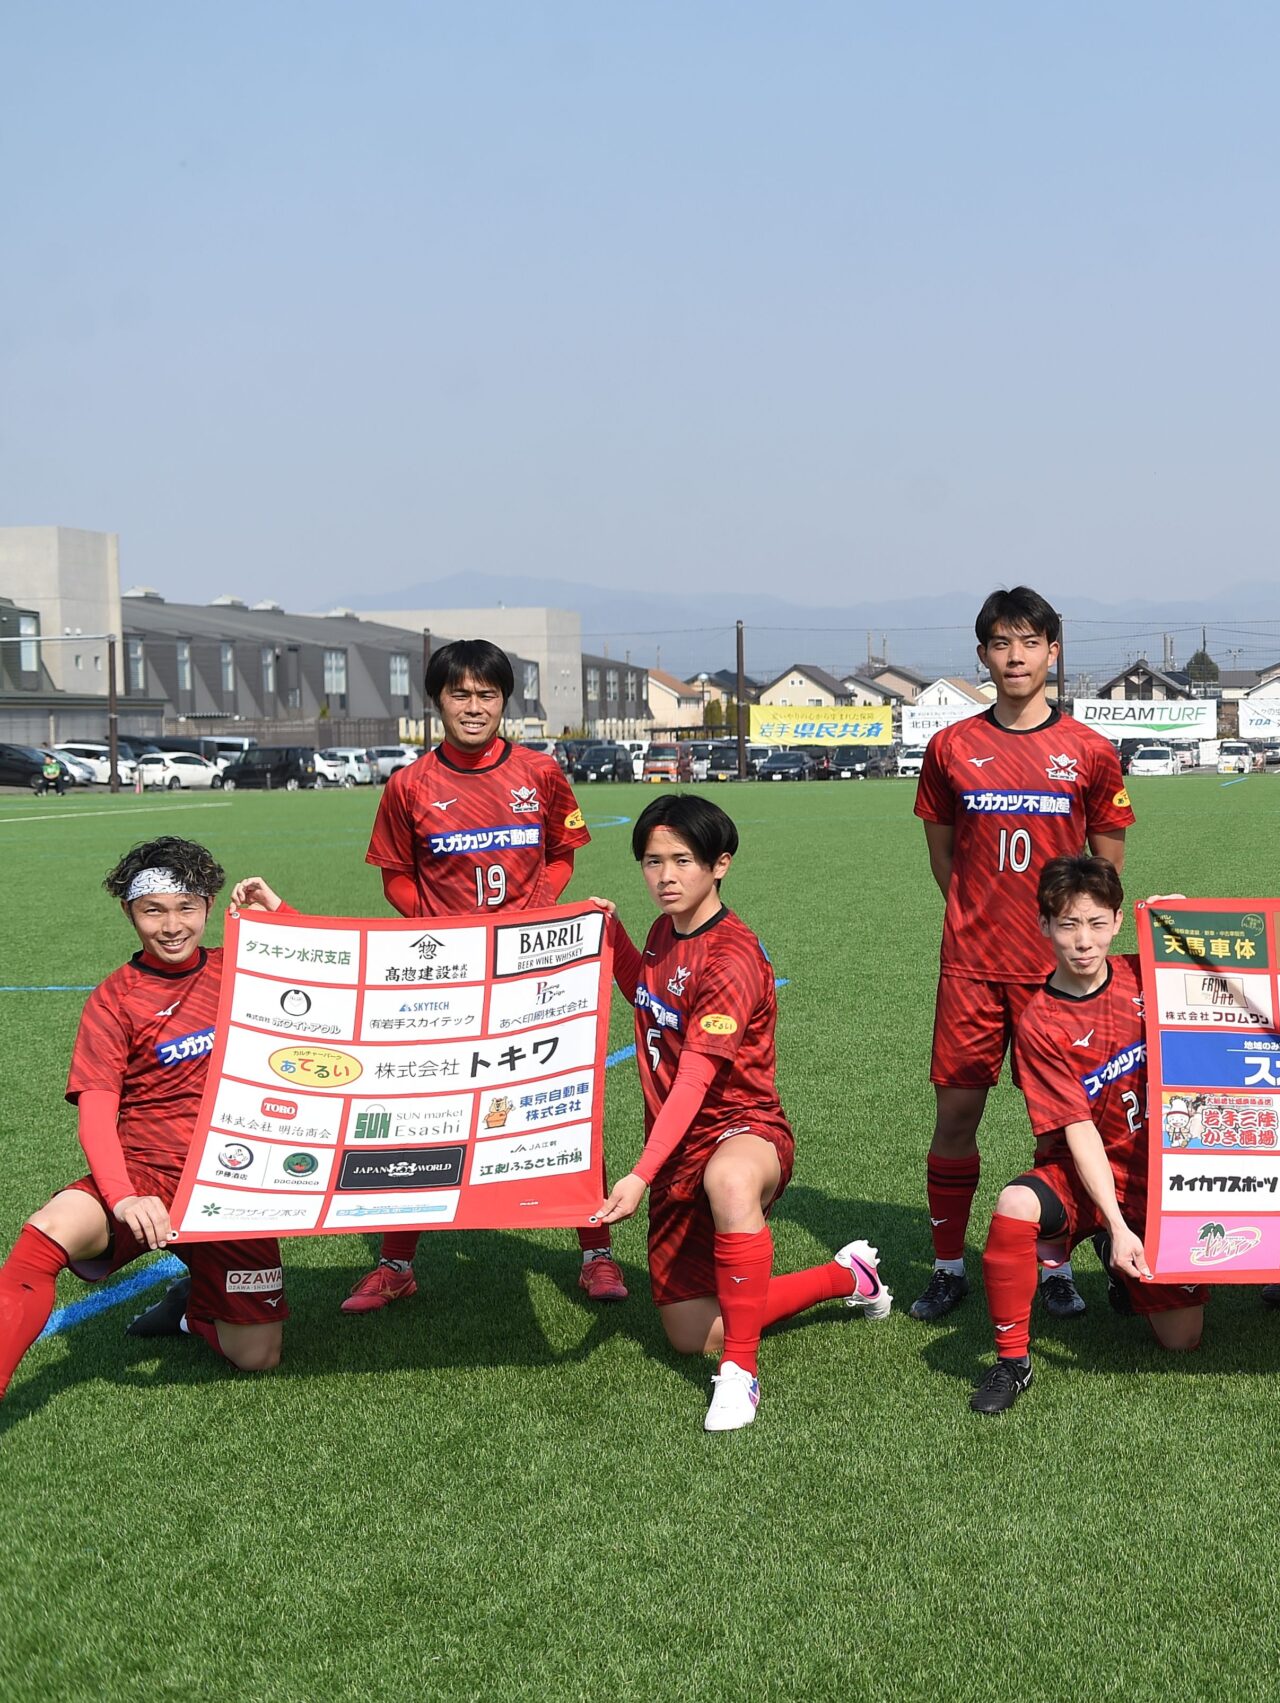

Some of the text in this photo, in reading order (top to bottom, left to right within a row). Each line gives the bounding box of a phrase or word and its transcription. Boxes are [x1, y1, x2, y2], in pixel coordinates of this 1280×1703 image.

[1084, 706, 1207, 721] DREAMTURF
[759, 722, 884, 739] 岩手 県民共済
[963, 792, 1071, 814] スガカツ不動産
[431, 828, 540, 854] スガカツ不動産
[998, 828, 1032, 873] 10
[475, 864, 506, 907] 19
[519, 923, 584, 954] BARRIL
[1163, 934, 1256, 960] 天馬車体
[246, 940, 351, 965] ダスキン水沢支店
[517, 948, 584, 971] BEER WINE WHISKEY
[413, 1001, 450, 1012] SKYTECH
[499, 998, 588, 1029] あべ印刷株式会社
[1165, 1011, 1270, 1025] 株式会社 フロムワン
[246, 1012, 341, 1035] 株式会社 ホワイトアウル
[280, 1058, 350, 1079] あてるい
[374, 1037, 560, 1080] 株式会社 トキワ
[519, 1082, 589, 1108] 東京自動車
[264, 1102, 295, 1115] TORO
[396, 1109, 463, 1121] SUN market
[525, 1099, 582, 1122] 株式会社
[220, 1112, 332, 1139] 株式会社 明治商会
[354, 1112, 392, 1139] SUN
[395, 1120, 461, 1137] Esashi
[1203, 1129, 1277, 1147] かき酒場
[353, 1163, 453, 1175] JAPAN WORLD
[480, 1149, 583, 1176] 江刺ふるさと市場
[1169, 1174, 1279, 1194] オイカワスポーツ
